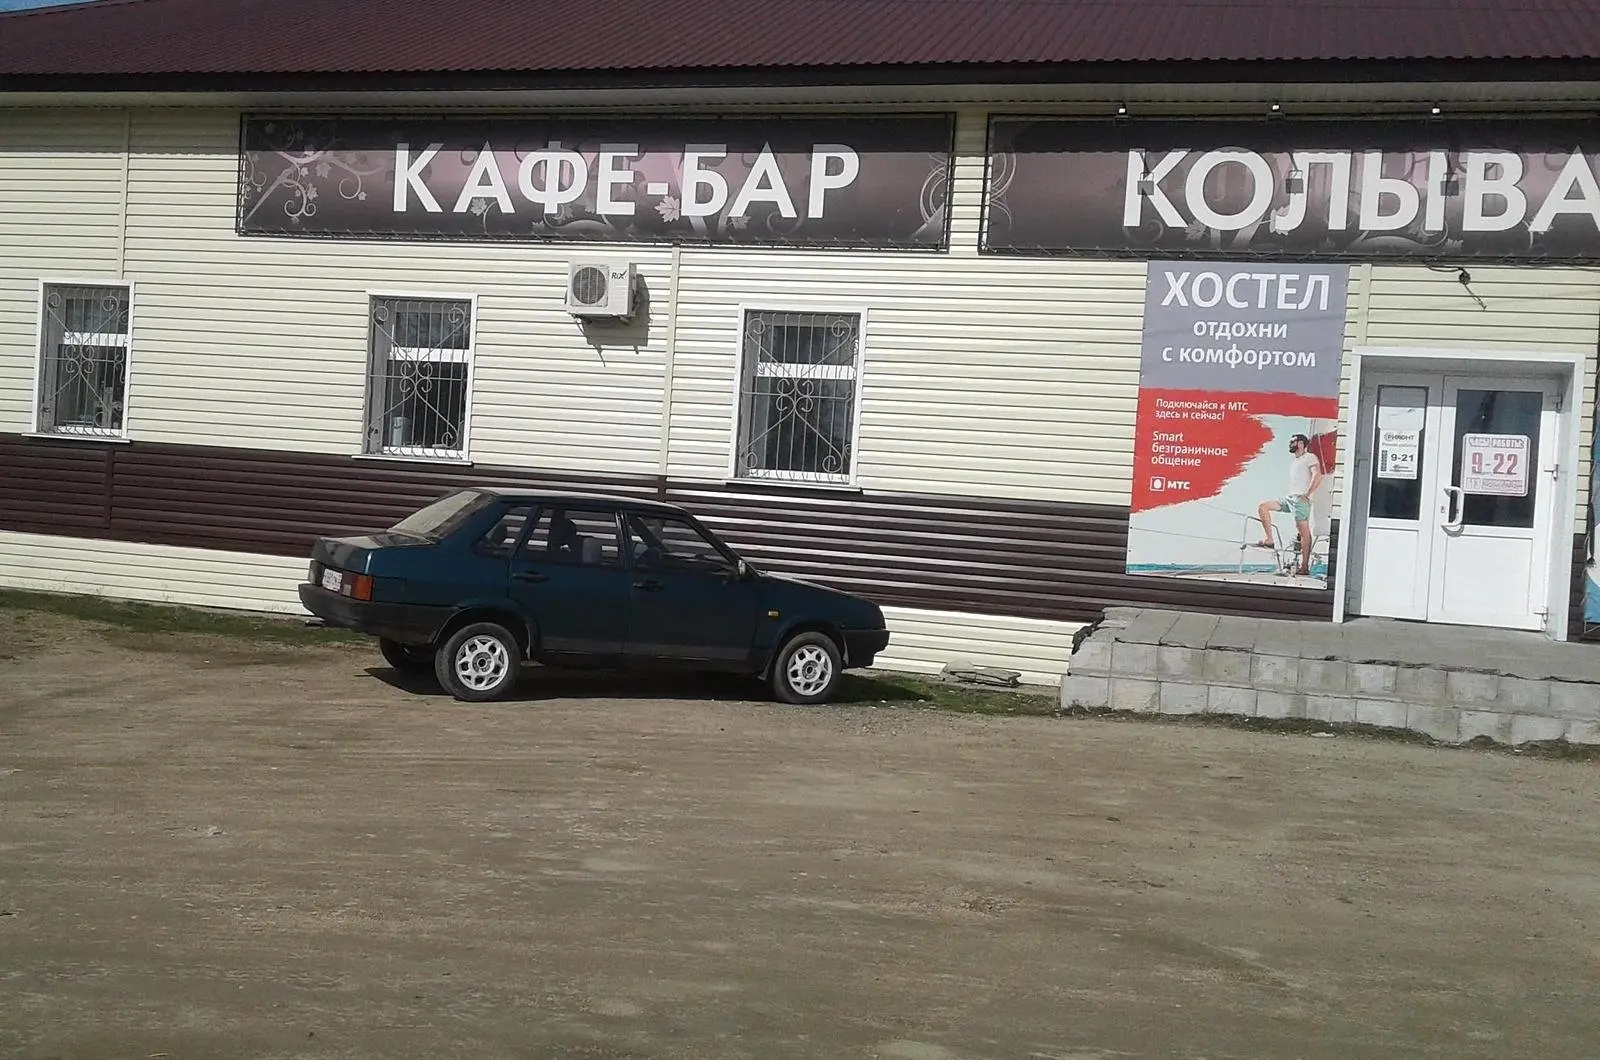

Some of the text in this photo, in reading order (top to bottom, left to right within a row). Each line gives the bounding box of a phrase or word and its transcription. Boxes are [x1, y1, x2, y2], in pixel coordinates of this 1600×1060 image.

[392, 140, 861, 219] КАФЕ-БАР
[1161, 271, 1331, 311] ХОСТЕЛ
[1193, 320, 1288, 341] отдохни
[1162, 344, 1316, 369] с комфортом
[1156, 398, 1249, 412] Подключайся к МТС
[1155, 410, 1225, 421] здесь и сейчас!
[1152, 431, 1184, 442] Smart
[1151, 442, 1228, 456] безграничное
[1151, 455, 1201, 467] общение
[1390, 453, 1414, 462] 9-21
[1167, 480, 1191, 490] МТС
